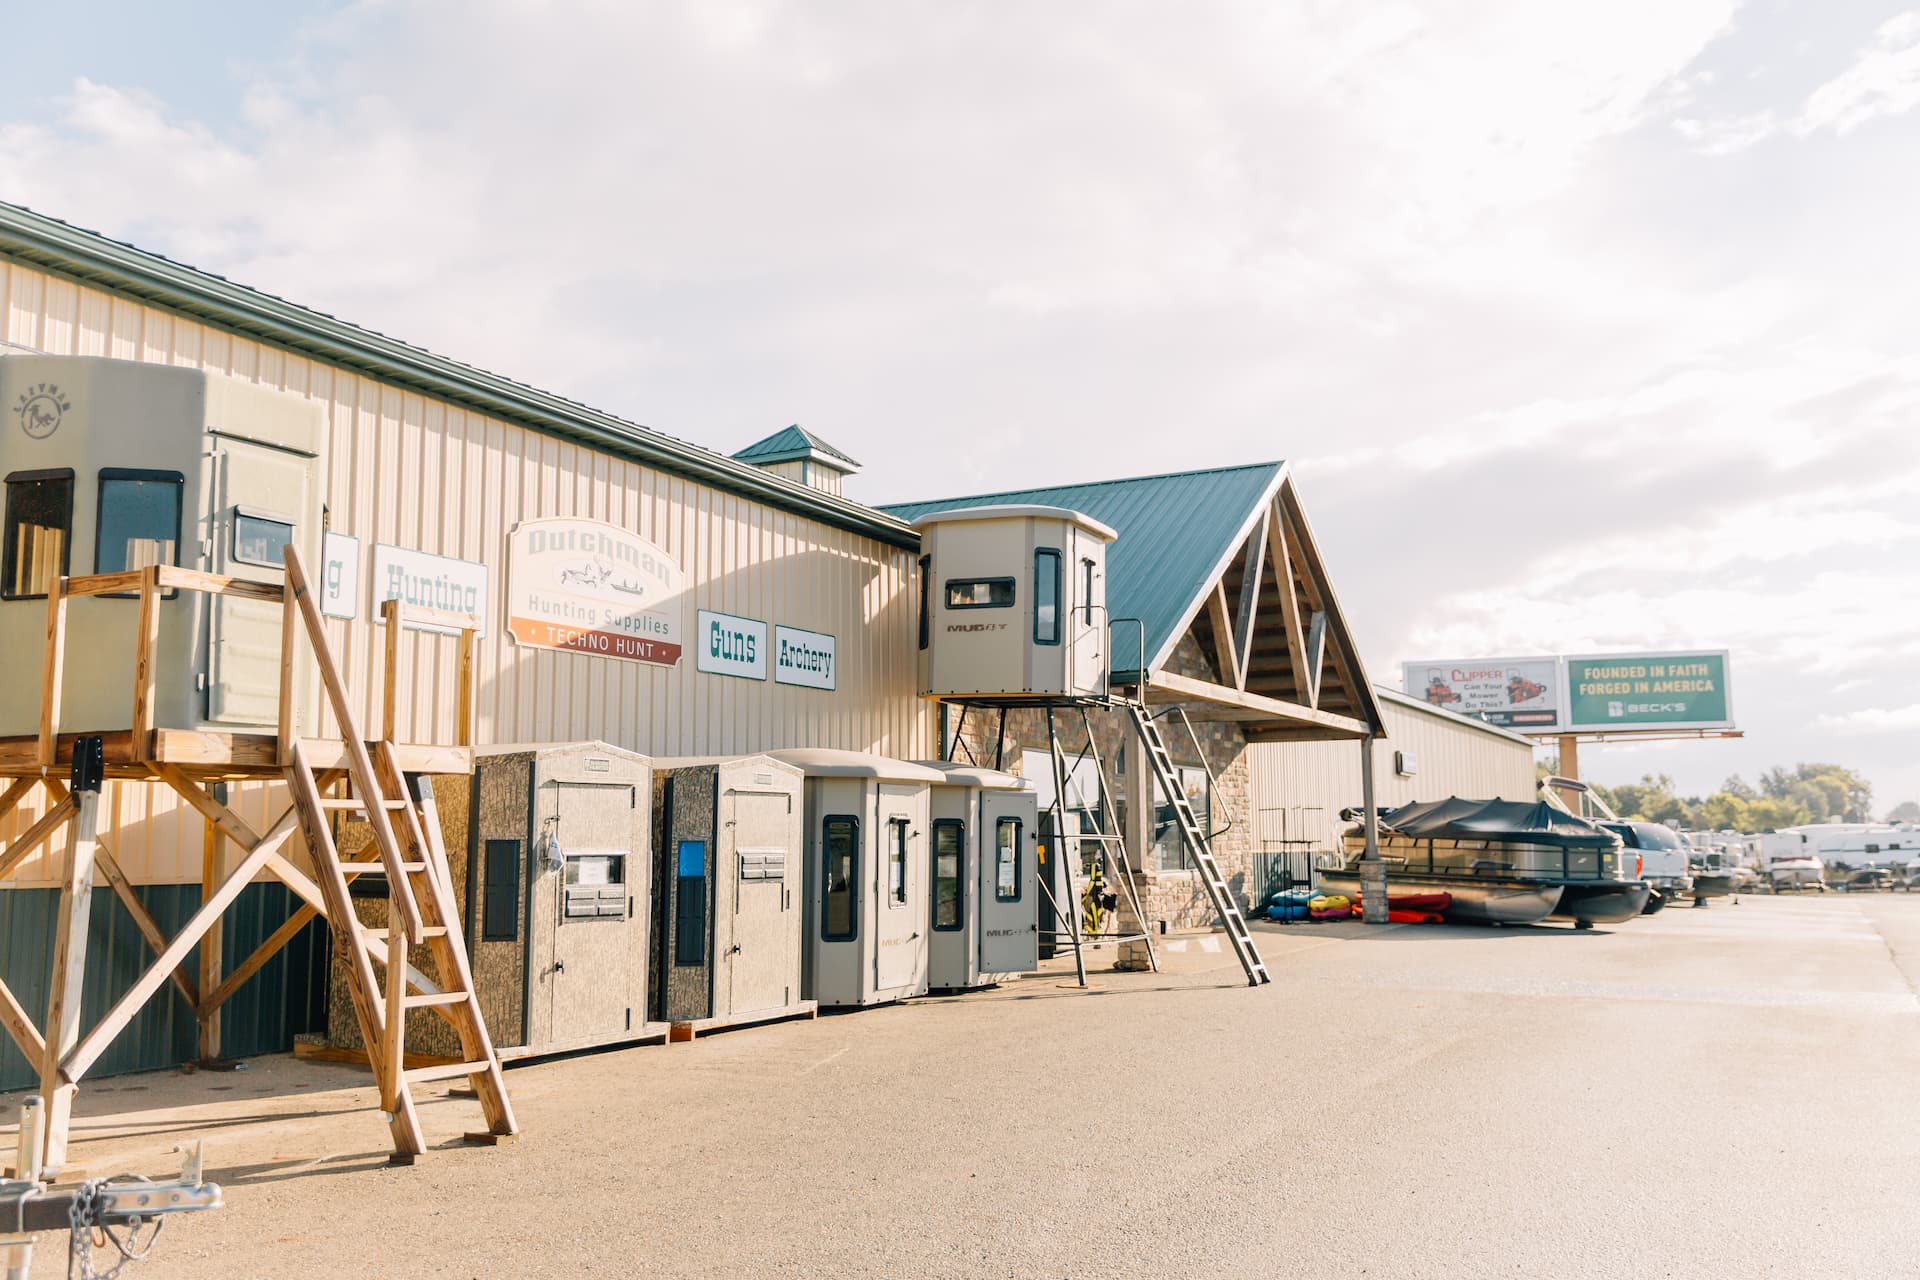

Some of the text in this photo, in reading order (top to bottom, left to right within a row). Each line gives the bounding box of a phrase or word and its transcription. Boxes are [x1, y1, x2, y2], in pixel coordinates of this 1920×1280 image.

[528, 528, 671, 590] Dutchman
[528, 594, 669, 635] Hunting Supplies
[546, 626, 654, 657] TECHNO HUNT
[710, 620, 756, 664] Guns
[779, 639, 832, 679] Archery
[1584, 663, 1709, 680] FOUNDED IN FAITH
[1451, 669, 1503, 682] CLIPPER
[1579, 679, 1714, 695] FORGED IN AMERICA
[1627, 702, 1687, 713] BECK'S
